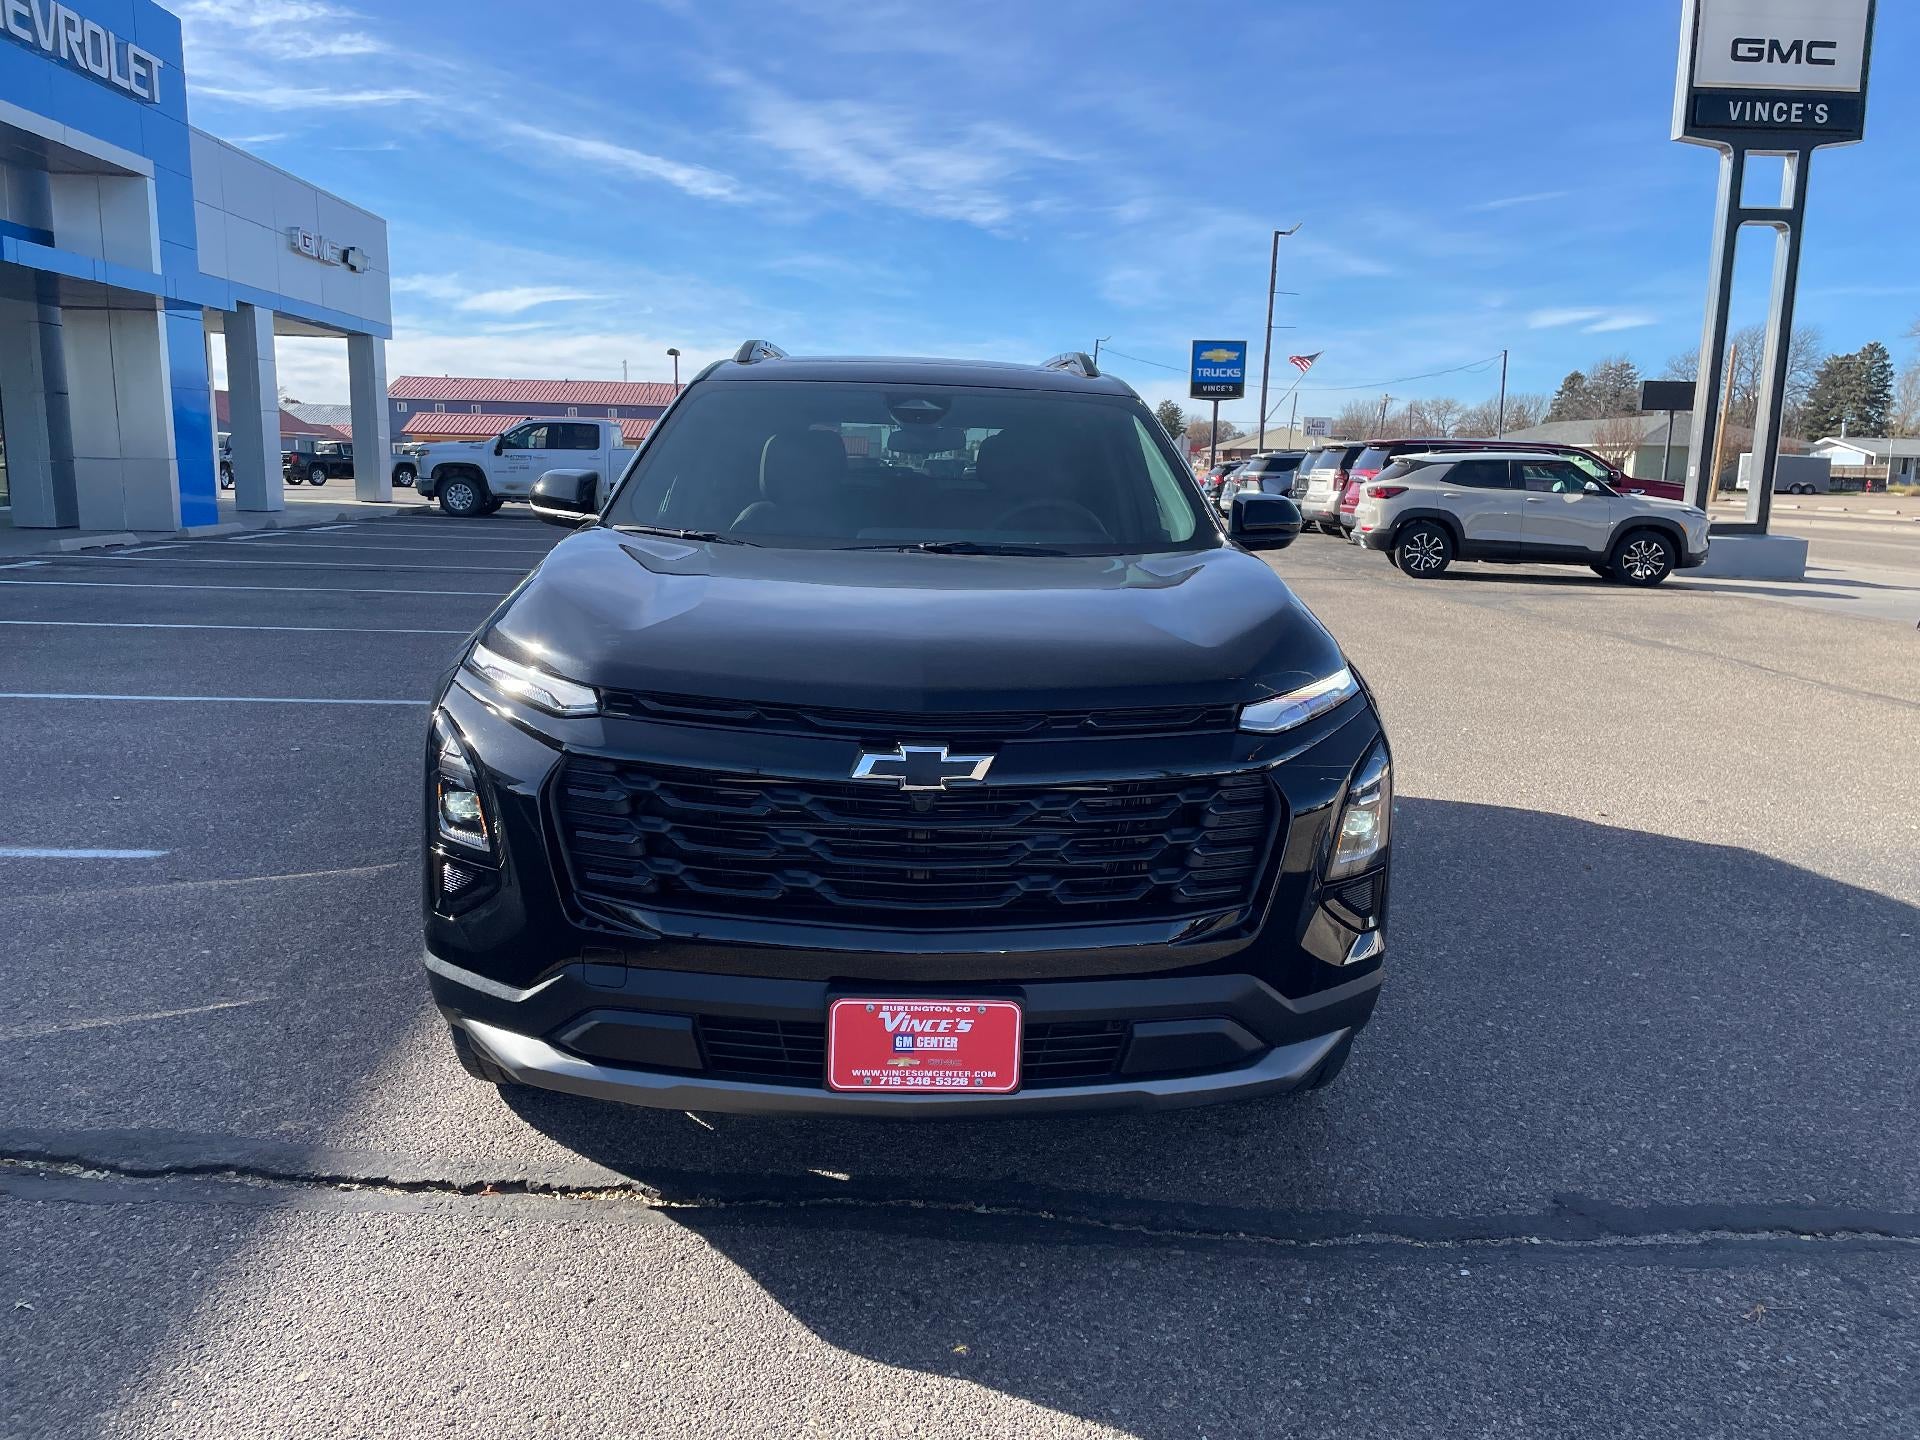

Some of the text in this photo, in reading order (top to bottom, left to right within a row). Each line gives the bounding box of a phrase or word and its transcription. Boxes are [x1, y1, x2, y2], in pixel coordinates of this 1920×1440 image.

[0, 0, 163, 104] EVROLET
[1730, 37, 1837, 66] GMC
[1728, 100, 1829, 124] VINCE'S
[1196, 367, 1241, 378] TRUCKS
[882, 1005, 953, 1013] BURLINGTON,
[895, 1035, 959, 1048] GM CENTER
[851, 1069, 997, 1078] WWW.VINCESGMCENTER.COM
[879, 1076, 969, 1086] 719-346-5326
